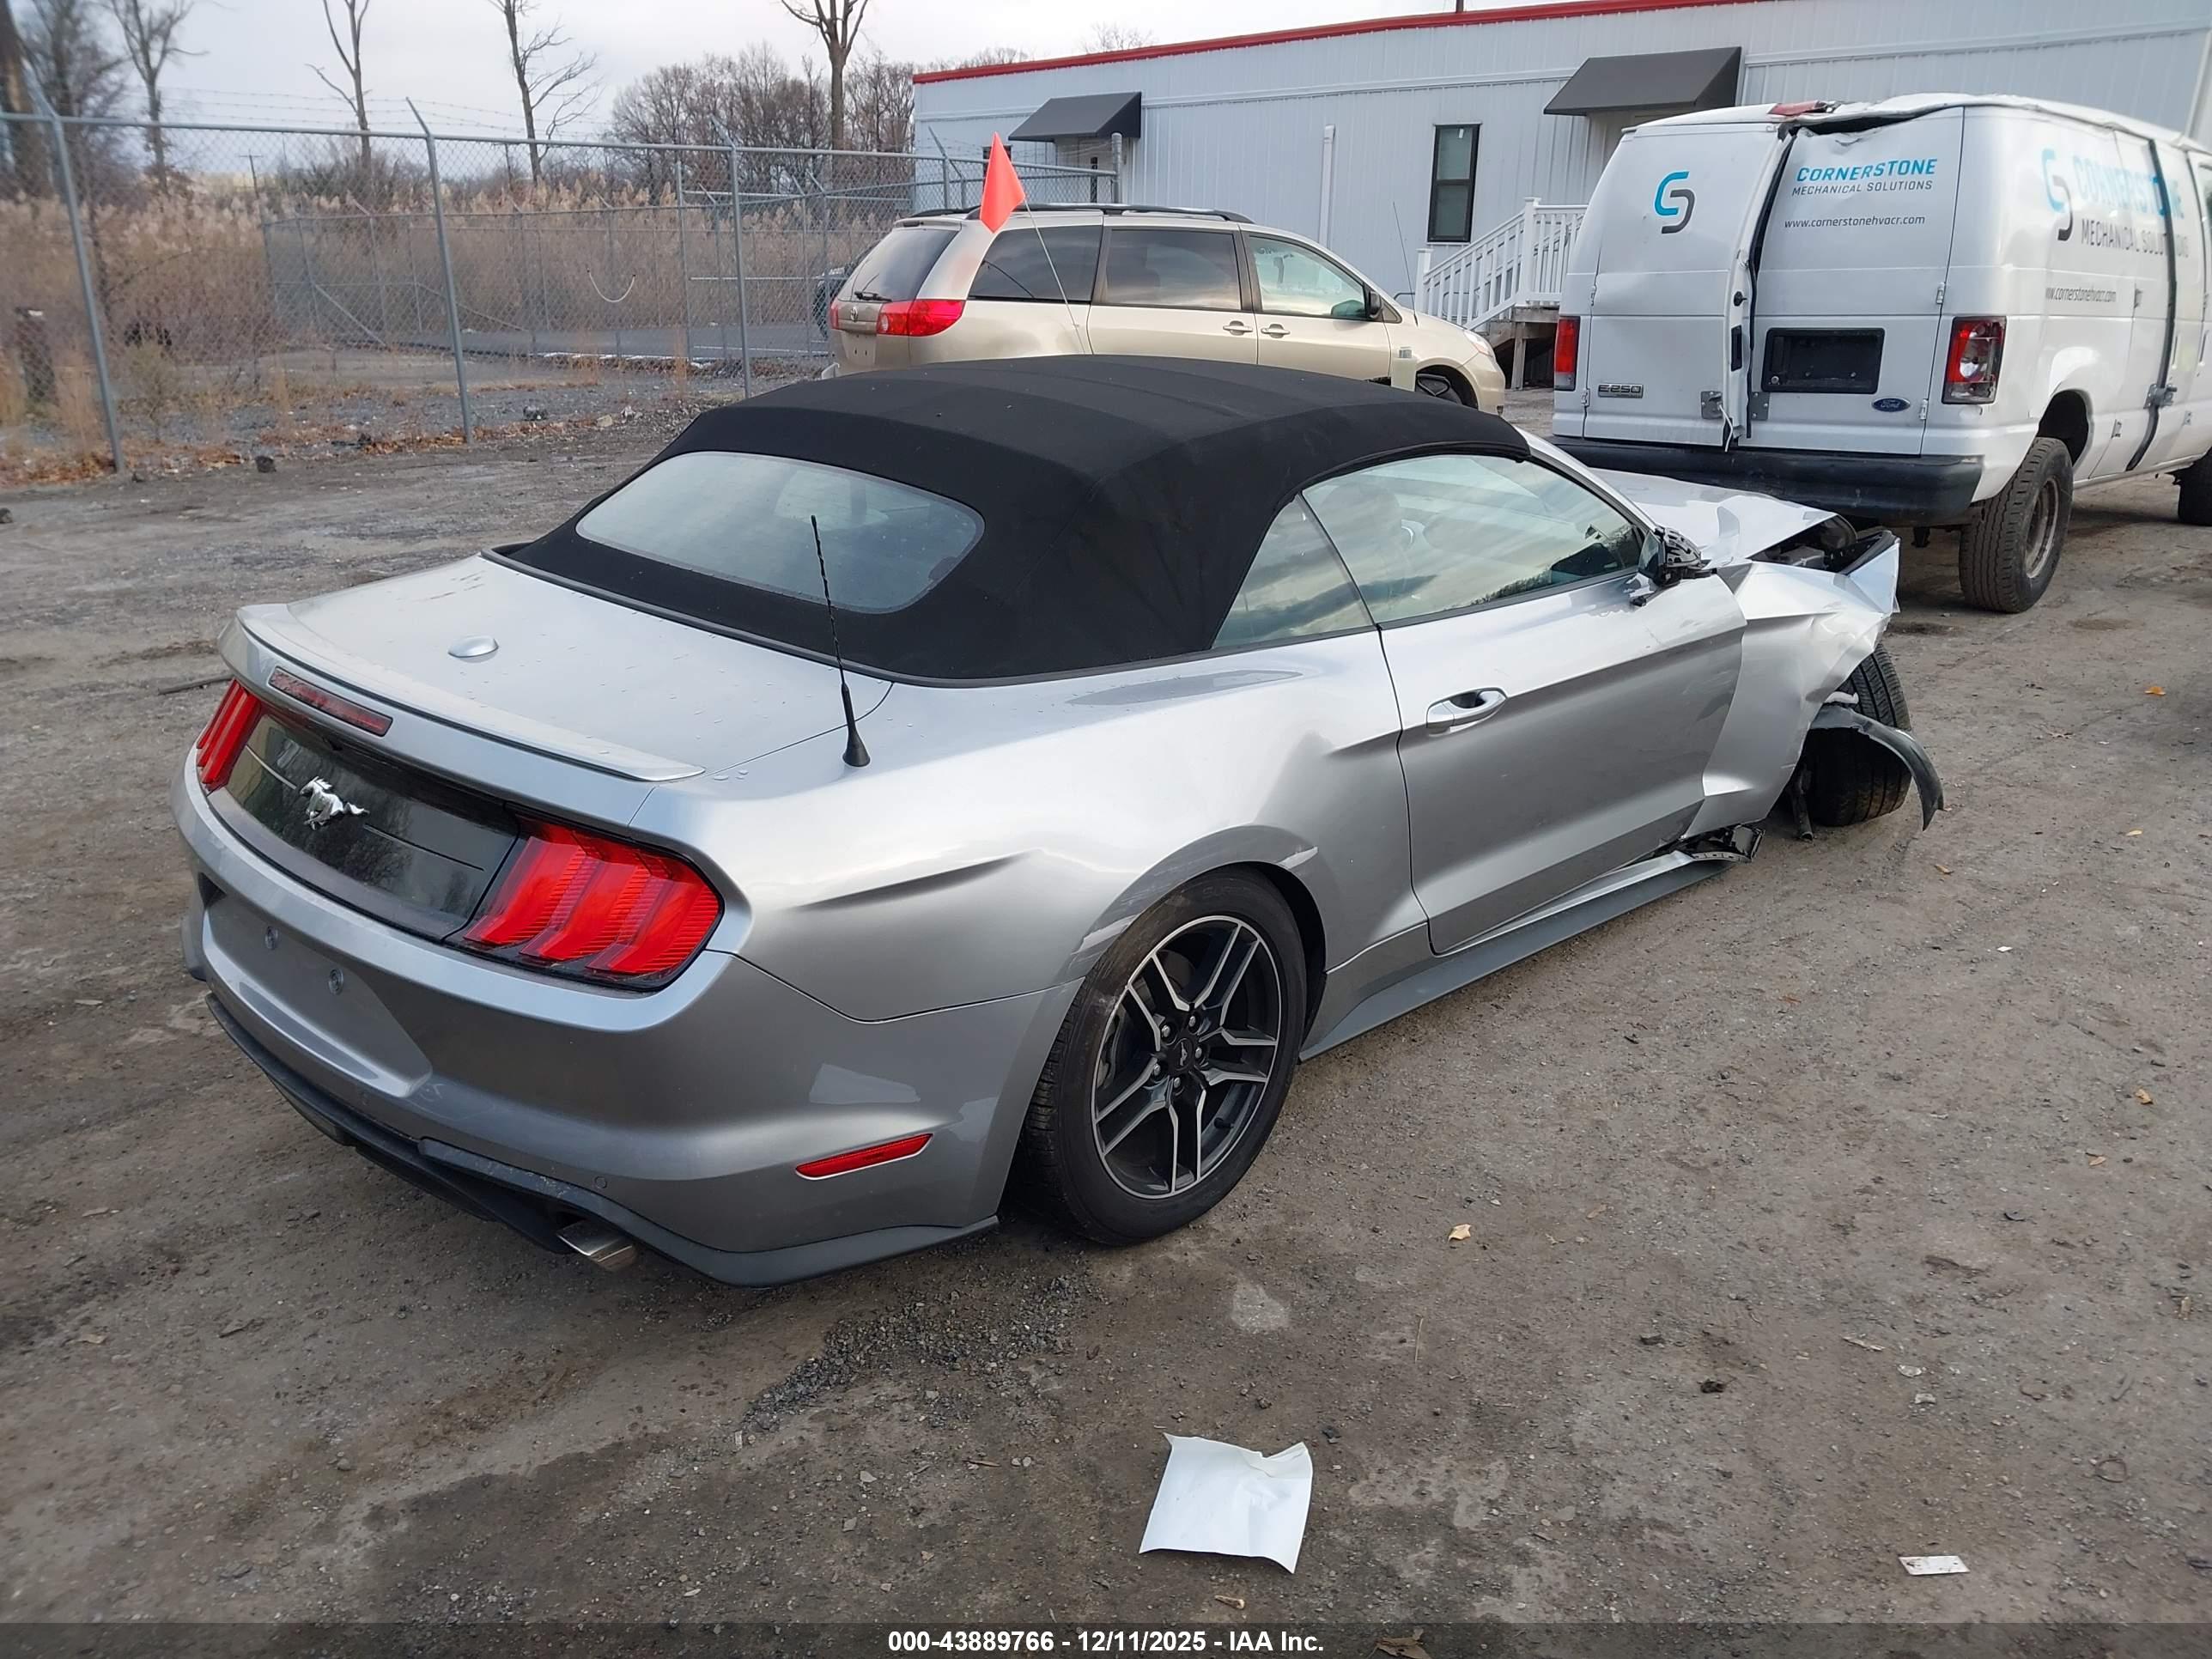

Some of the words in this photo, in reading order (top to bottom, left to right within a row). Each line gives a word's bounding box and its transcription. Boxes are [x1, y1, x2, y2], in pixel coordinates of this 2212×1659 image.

[1796, 159, 1937, 182] CORNERSTONE
[1792, 184, 1862, 196] MECHANICAL
[1867, 179, 1933, 191] SOLUTIONS
[1784, 216, 1925, 228] www.cornerstonehvacr.com
